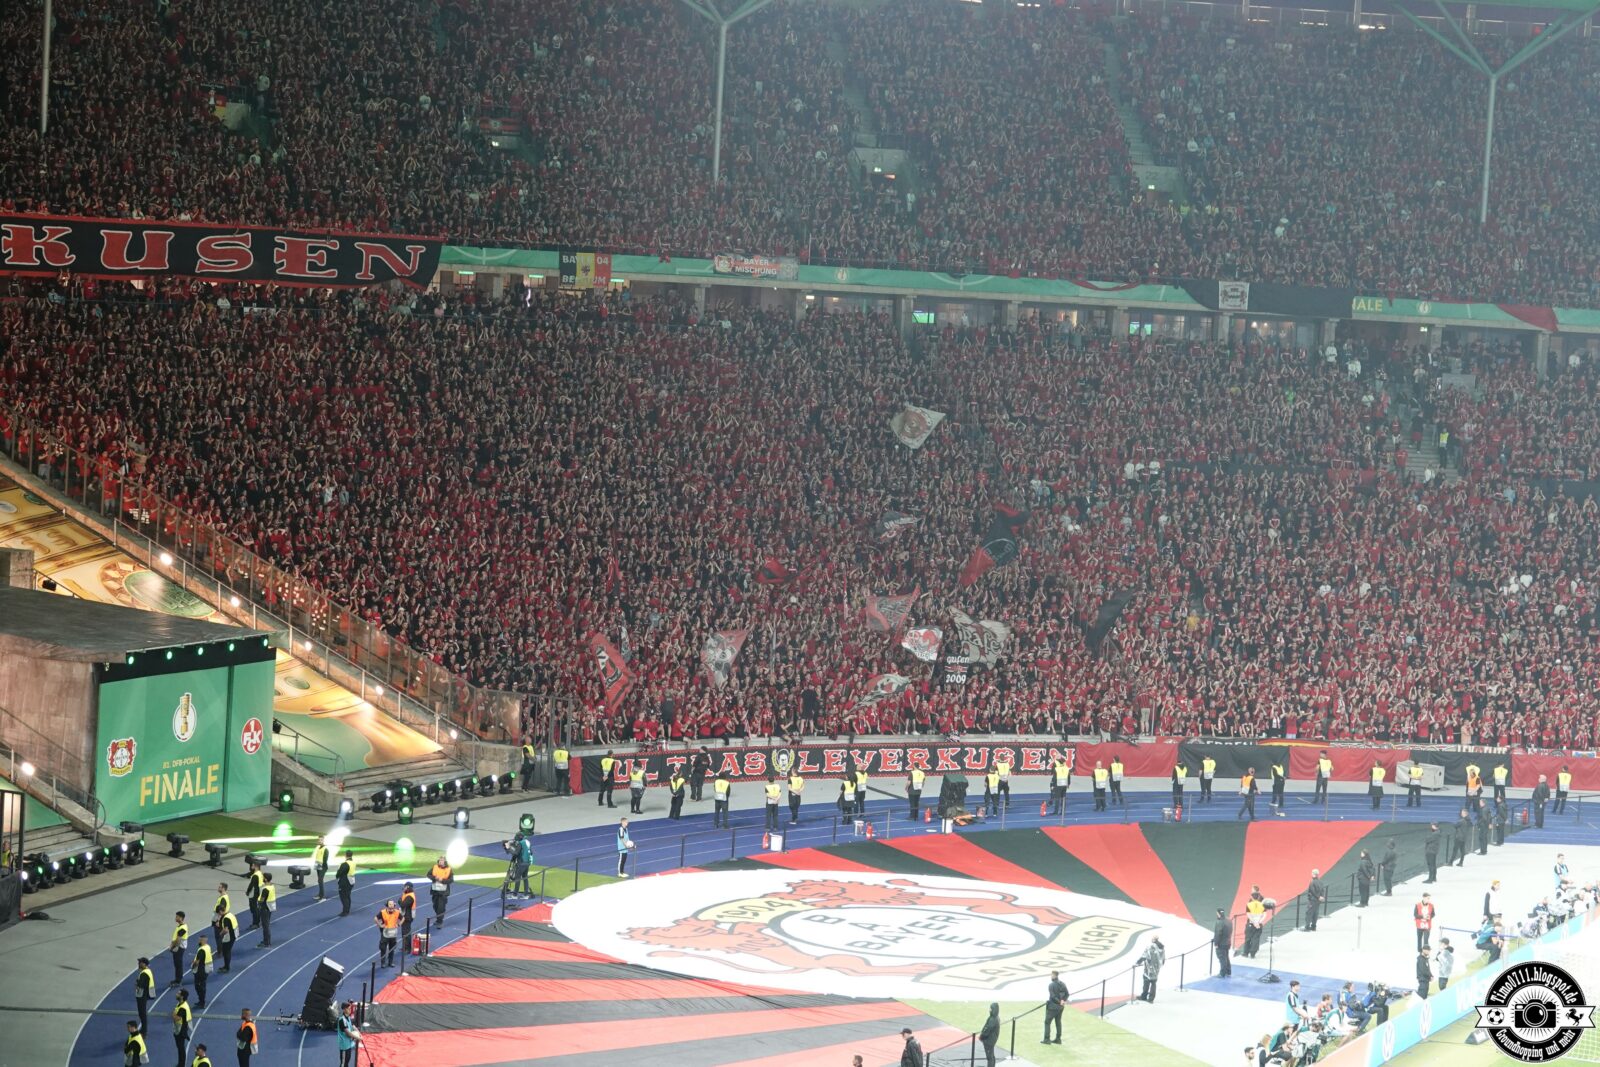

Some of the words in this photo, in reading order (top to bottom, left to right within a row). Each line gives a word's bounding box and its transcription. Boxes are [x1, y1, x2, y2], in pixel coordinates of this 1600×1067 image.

[1, 223, 427, 281] KUSEN
[596, 256, 609, 265] 04
[562, 274, 606, 284] BEUM
[735, 266, 777, 275] MISCHUNG
[945, 674, 966, 684] 2009
[614, 752, 767, 783] ULTAS
[798, 747, 1075, 773] LEVERKUSEN
[140, 764, 220, 807] FINALE
[716, 900, 797, 919] 1904
[845, 915, 971, 950] BAYER
[944, 924, 1131, 983] Leverkusen
